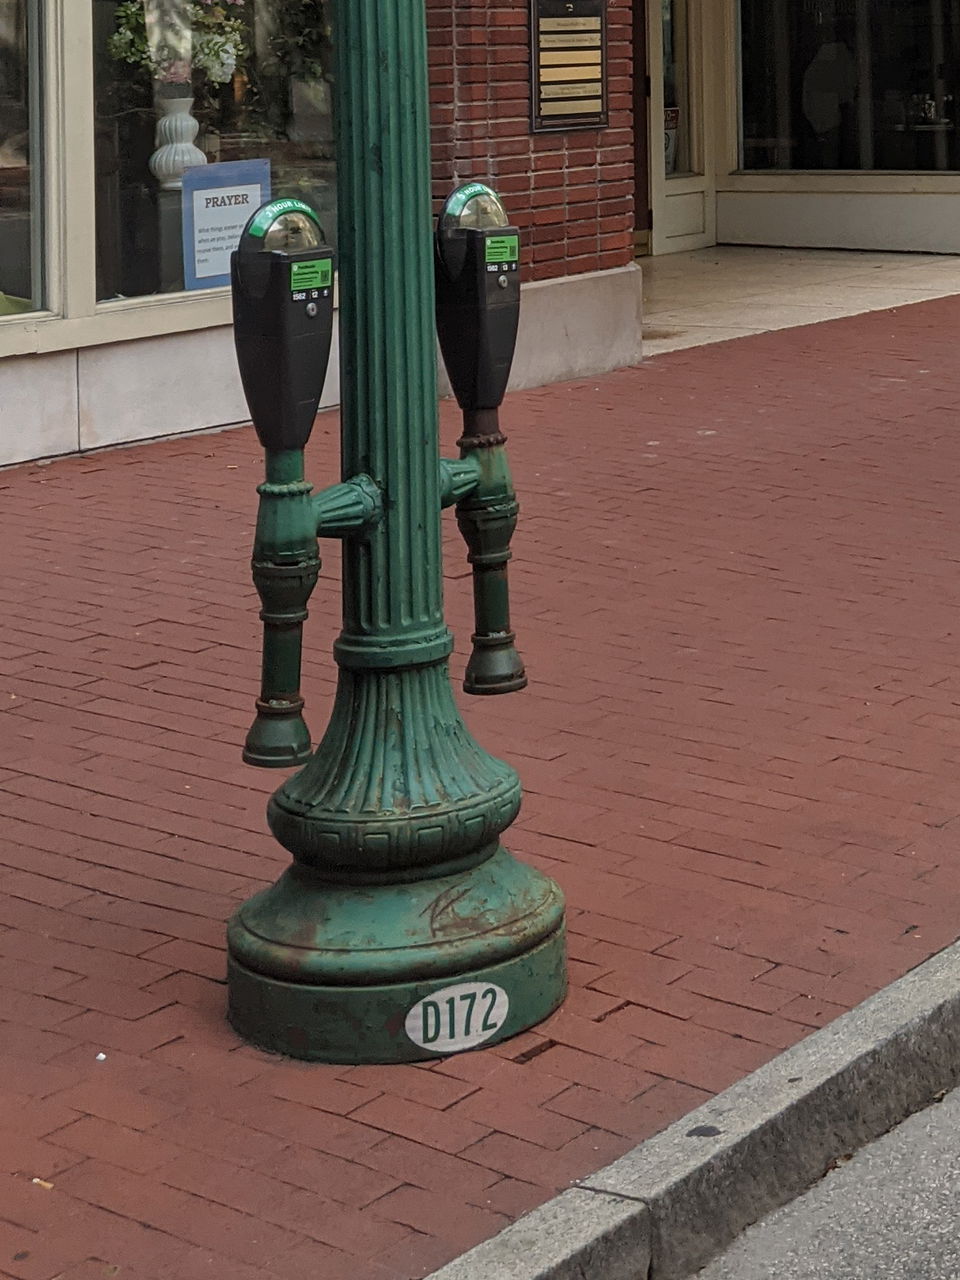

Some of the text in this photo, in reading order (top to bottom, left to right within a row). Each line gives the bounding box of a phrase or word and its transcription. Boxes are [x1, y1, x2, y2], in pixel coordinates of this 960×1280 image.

[205, 193, 250, 209] PRAYER
[271, 201, 293, 213] HOUR
[421, 987, 498, 1044] D172
